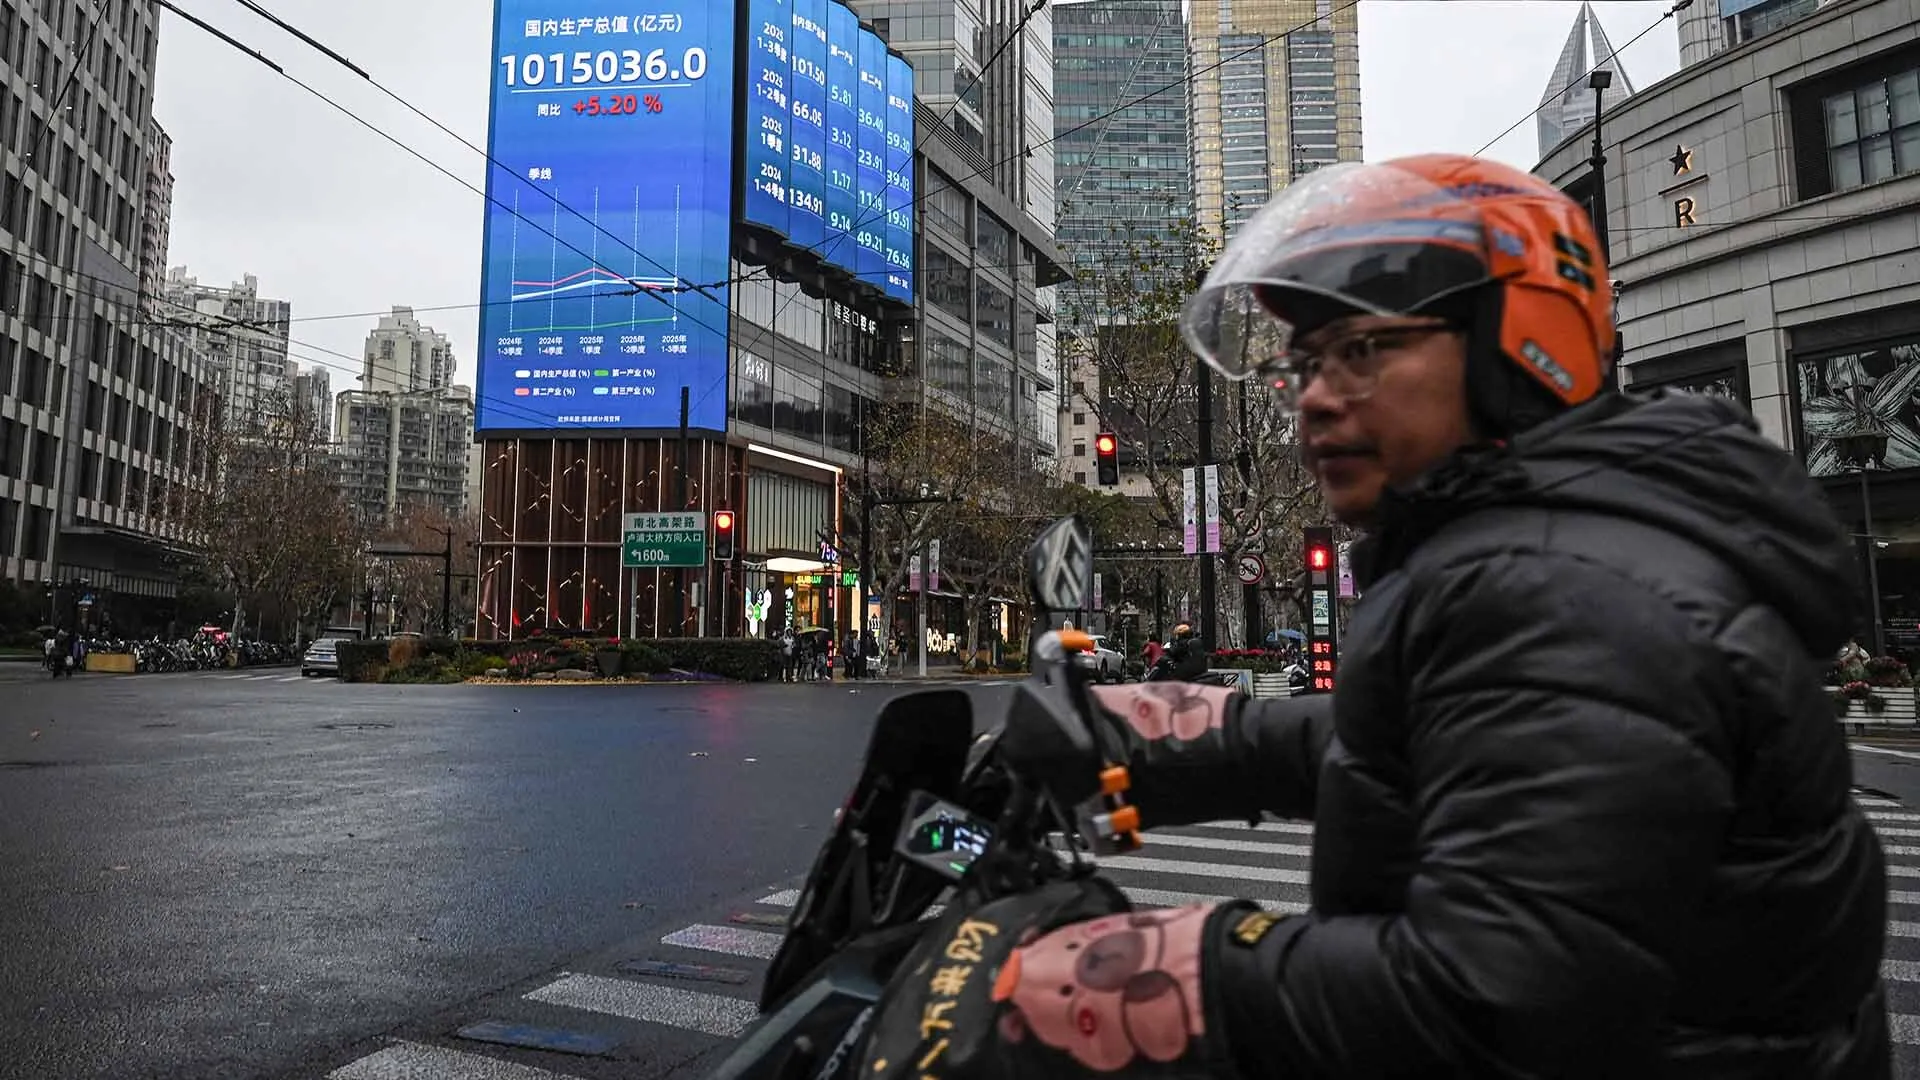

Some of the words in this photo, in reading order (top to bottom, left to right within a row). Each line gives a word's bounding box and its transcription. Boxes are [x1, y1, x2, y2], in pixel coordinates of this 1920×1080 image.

[763, 22, 785, 42] 2025
[501, 47, 707, 87] 1015036.0
[792, 55, 826, 86] 101.50
[762, 68, 784, 89] 2025
[572, 95, 638, 116] +5.20
[643, 93, 663, 114] %
[831, 85, 852, 108] 5.81
[537, 104, 561, 117] 同比
[792, 100, 823, 128] 66.05
[858, 108, 884, 134] 36.40
[761, 116, 783, 136] 2025
[831, 128, 852, 150] 3.12
[887, 131, 911, 154] 59.30
[792, 144, 822, 171] 31.88
[858, 149, 884, 173] 23.91
[528, 168, 553, 181] 季线
[760, 162, 782, 182] 2024
[832, 169, 851, 190] 1.17
[788, 188, 823, 217] 134.91
[859, 190, 883, 212] 11.19
[830, 212, 850, 233] 9.14
[887, 209, 910, 231] 19.51
[1674, 198, 1695, 228] R
[857, 230, 884, 253] 49.21
[886, 247, 910, 269] 76.56
[498, 337, 523, 346] 2024年
[538, 336, 563, 346] 2024年
[579, 336, 604, 345] 2025年
[620, 335, 646, 345] 2025年
[661, 334, 687, 344] 2025年
[633, 516, 695, 529] 南北高架路
